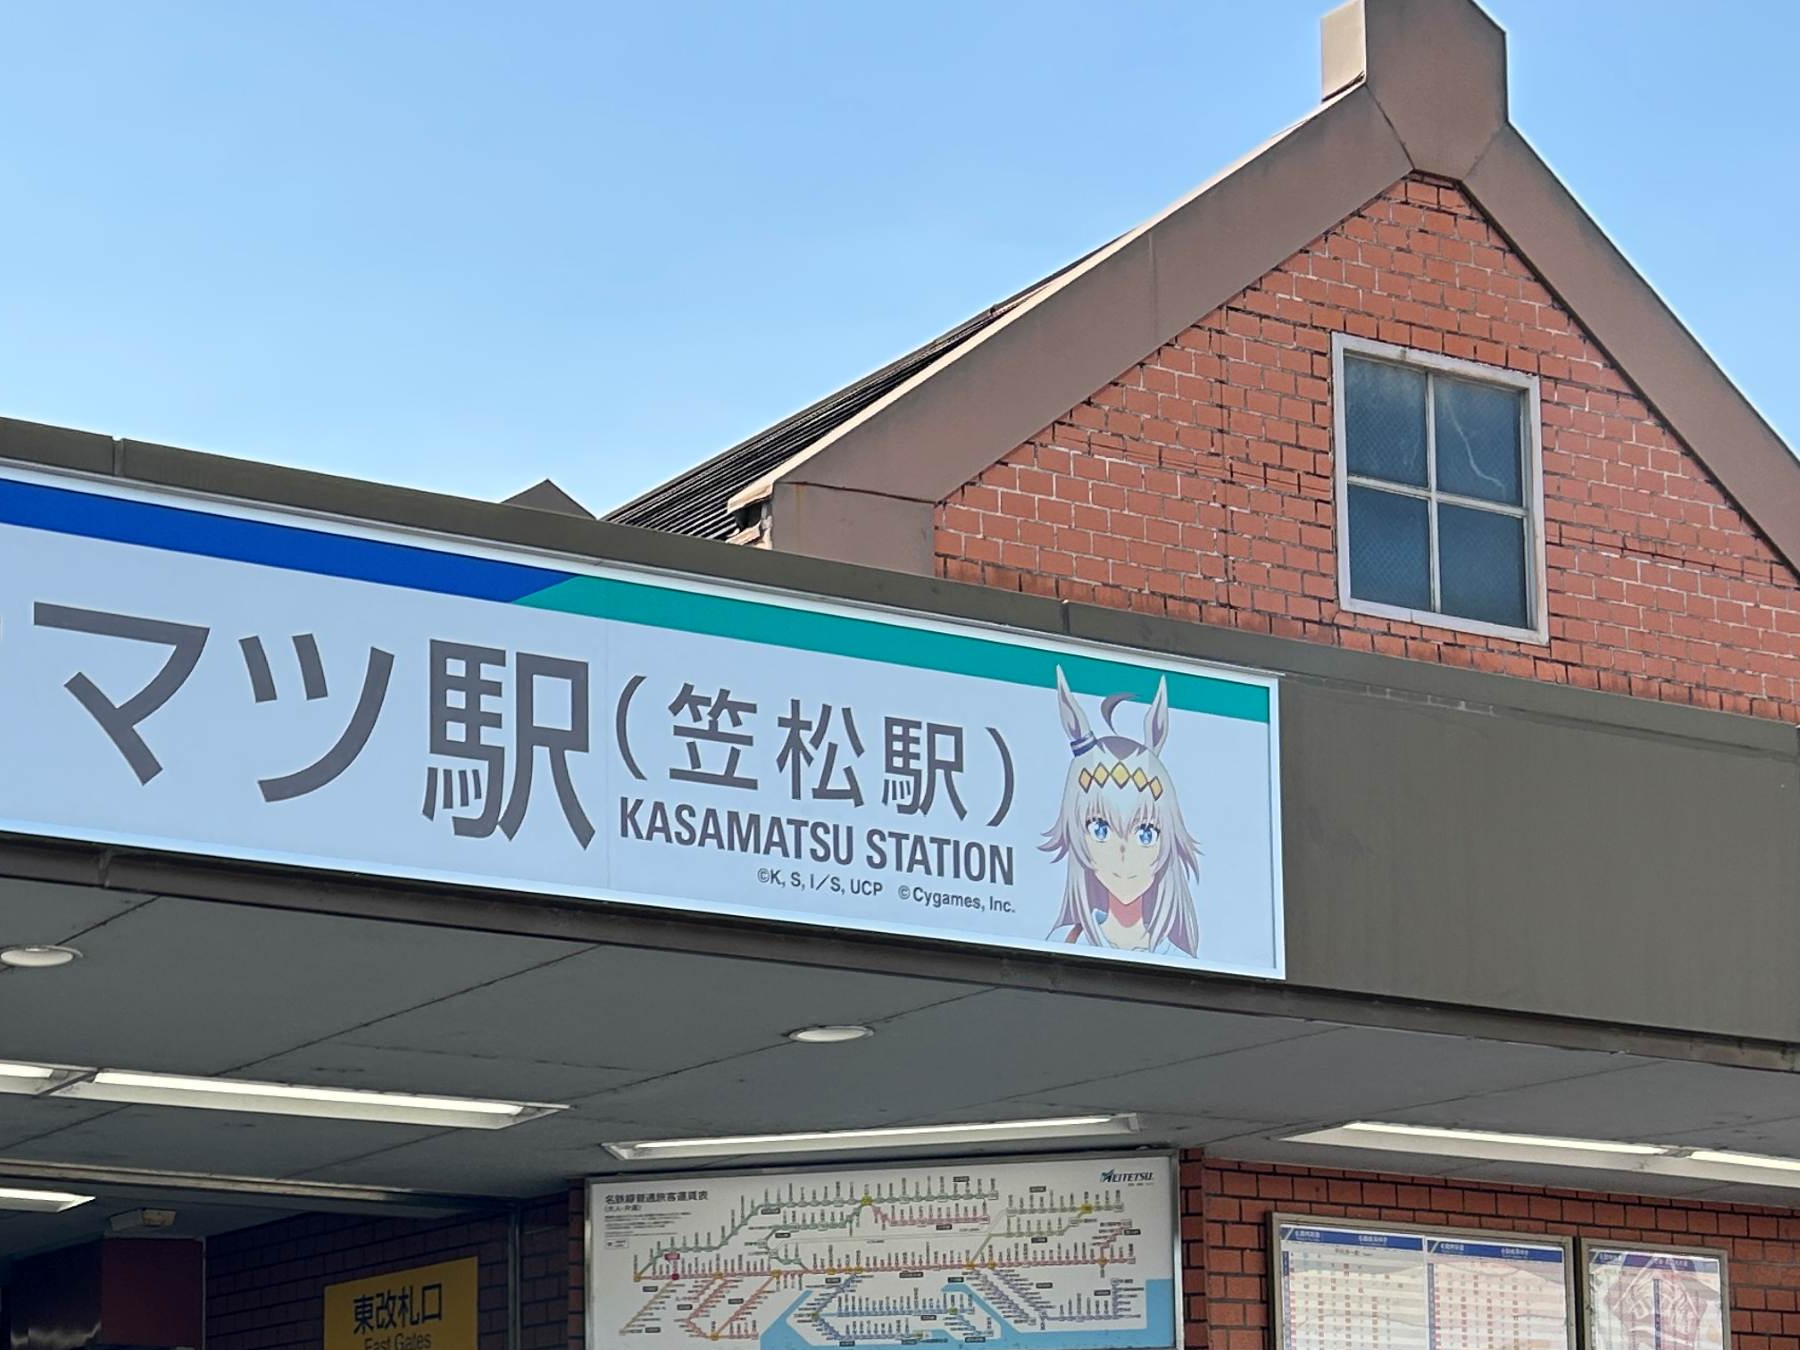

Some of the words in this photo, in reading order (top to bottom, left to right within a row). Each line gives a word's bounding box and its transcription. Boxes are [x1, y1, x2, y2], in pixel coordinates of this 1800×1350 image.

[620, 797, 854, 866] KASAMATSU
[866, 828, 1014, 886] STATION
[850, 878, 883, 897] UCP
[989, 898, 1016, 914] Inc.
[353, 1283, 442, 1335] 東改札口
